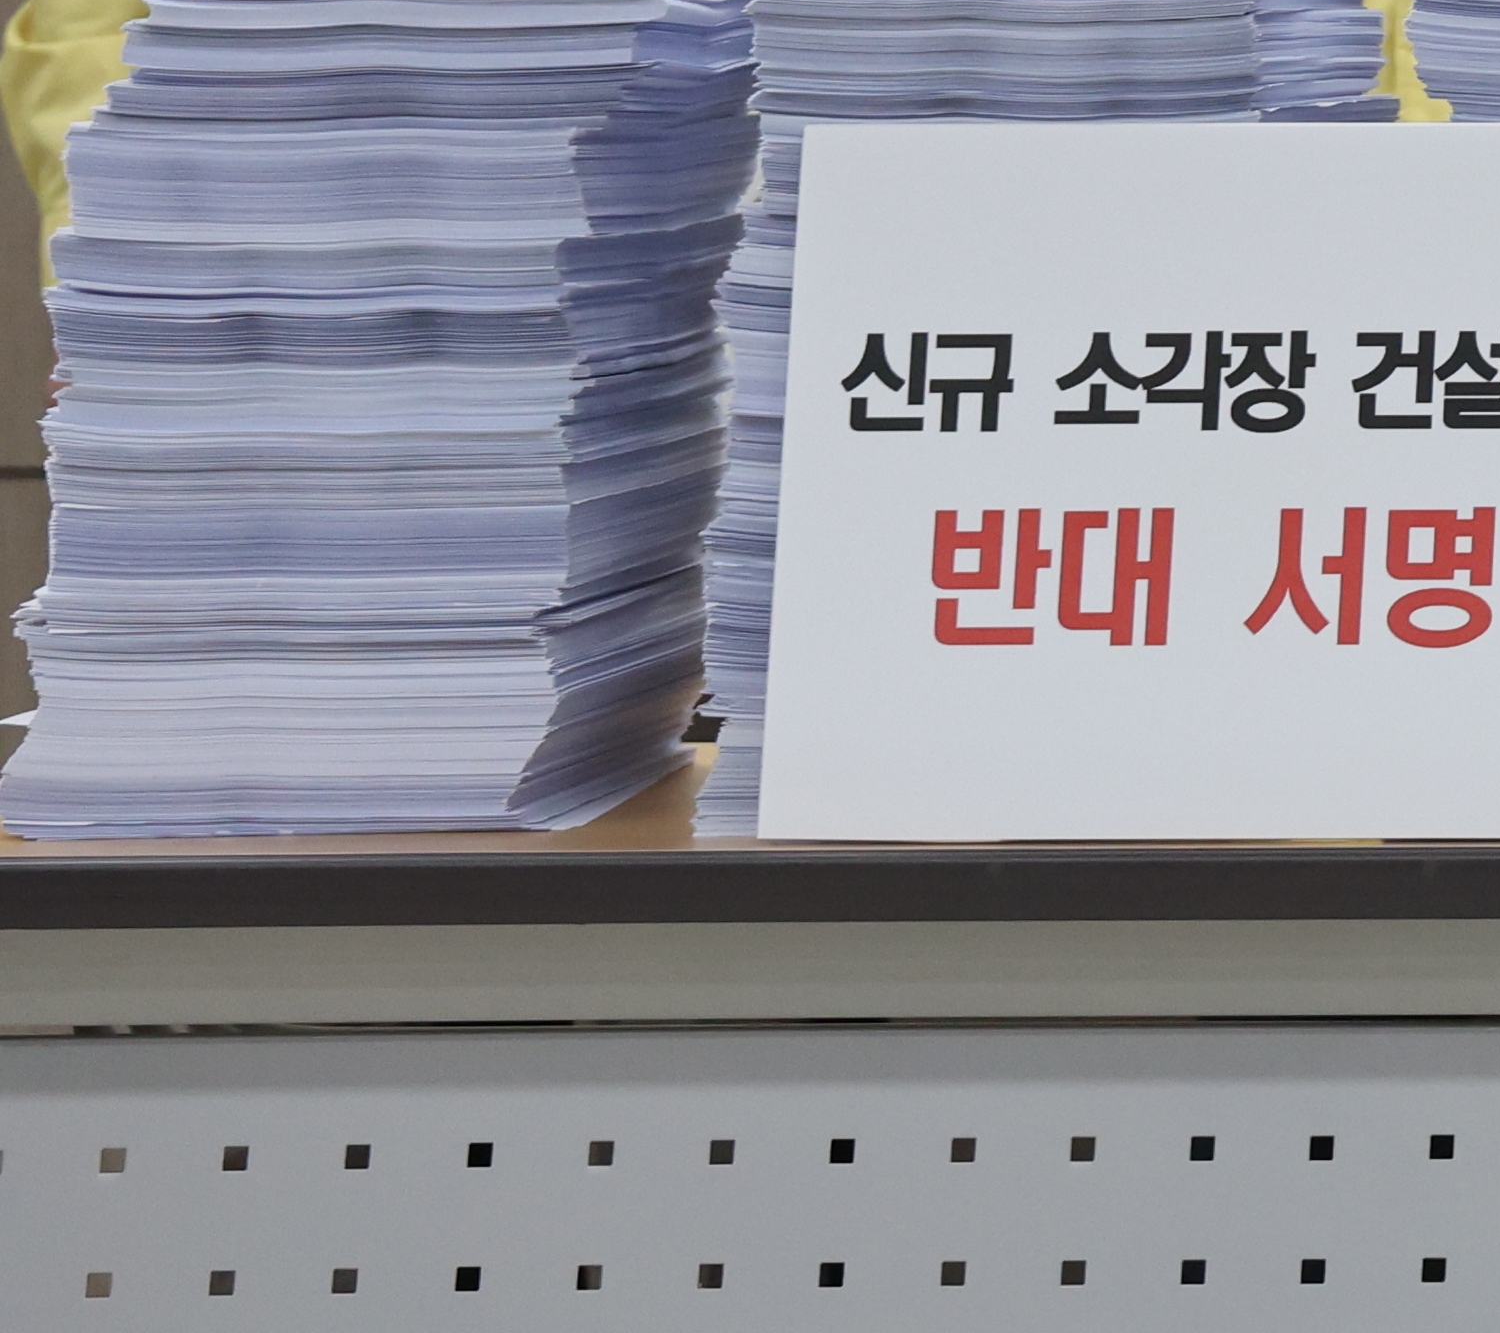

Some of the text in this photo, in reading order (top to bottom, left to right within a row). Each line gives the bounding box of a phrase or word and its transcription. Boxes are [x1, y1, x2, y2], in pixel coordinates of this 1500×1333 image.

[841, 332, 1014, 432] 신규
[1054, 330, 1317, 433] 소각장
[931, 508, 1175, 646] 반대
